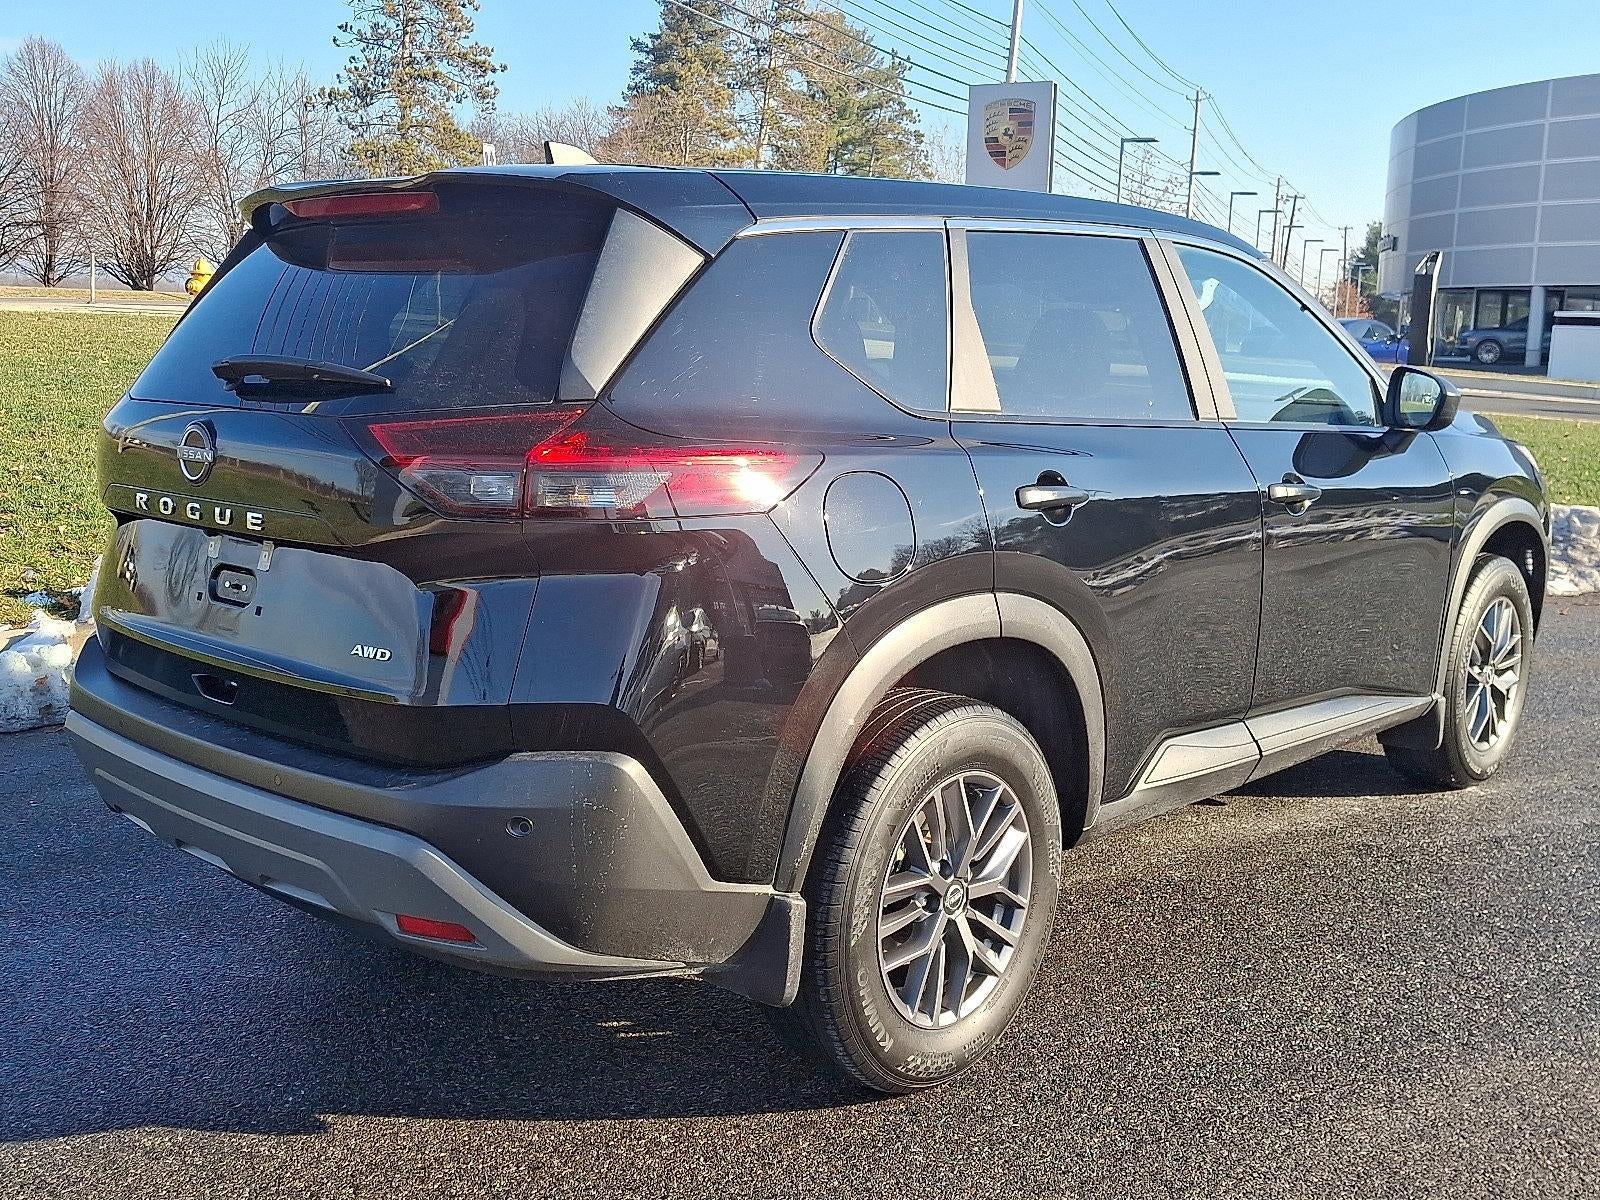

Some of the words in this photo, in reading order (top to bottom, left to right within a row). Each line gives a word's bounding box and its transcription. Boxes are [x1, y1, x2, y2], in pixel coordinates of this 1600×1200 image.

[135, 492, 264, 531] ROGUE
[350, 644, 391, 661] AWD
[857, 968, 894, 1053] KUMHO
